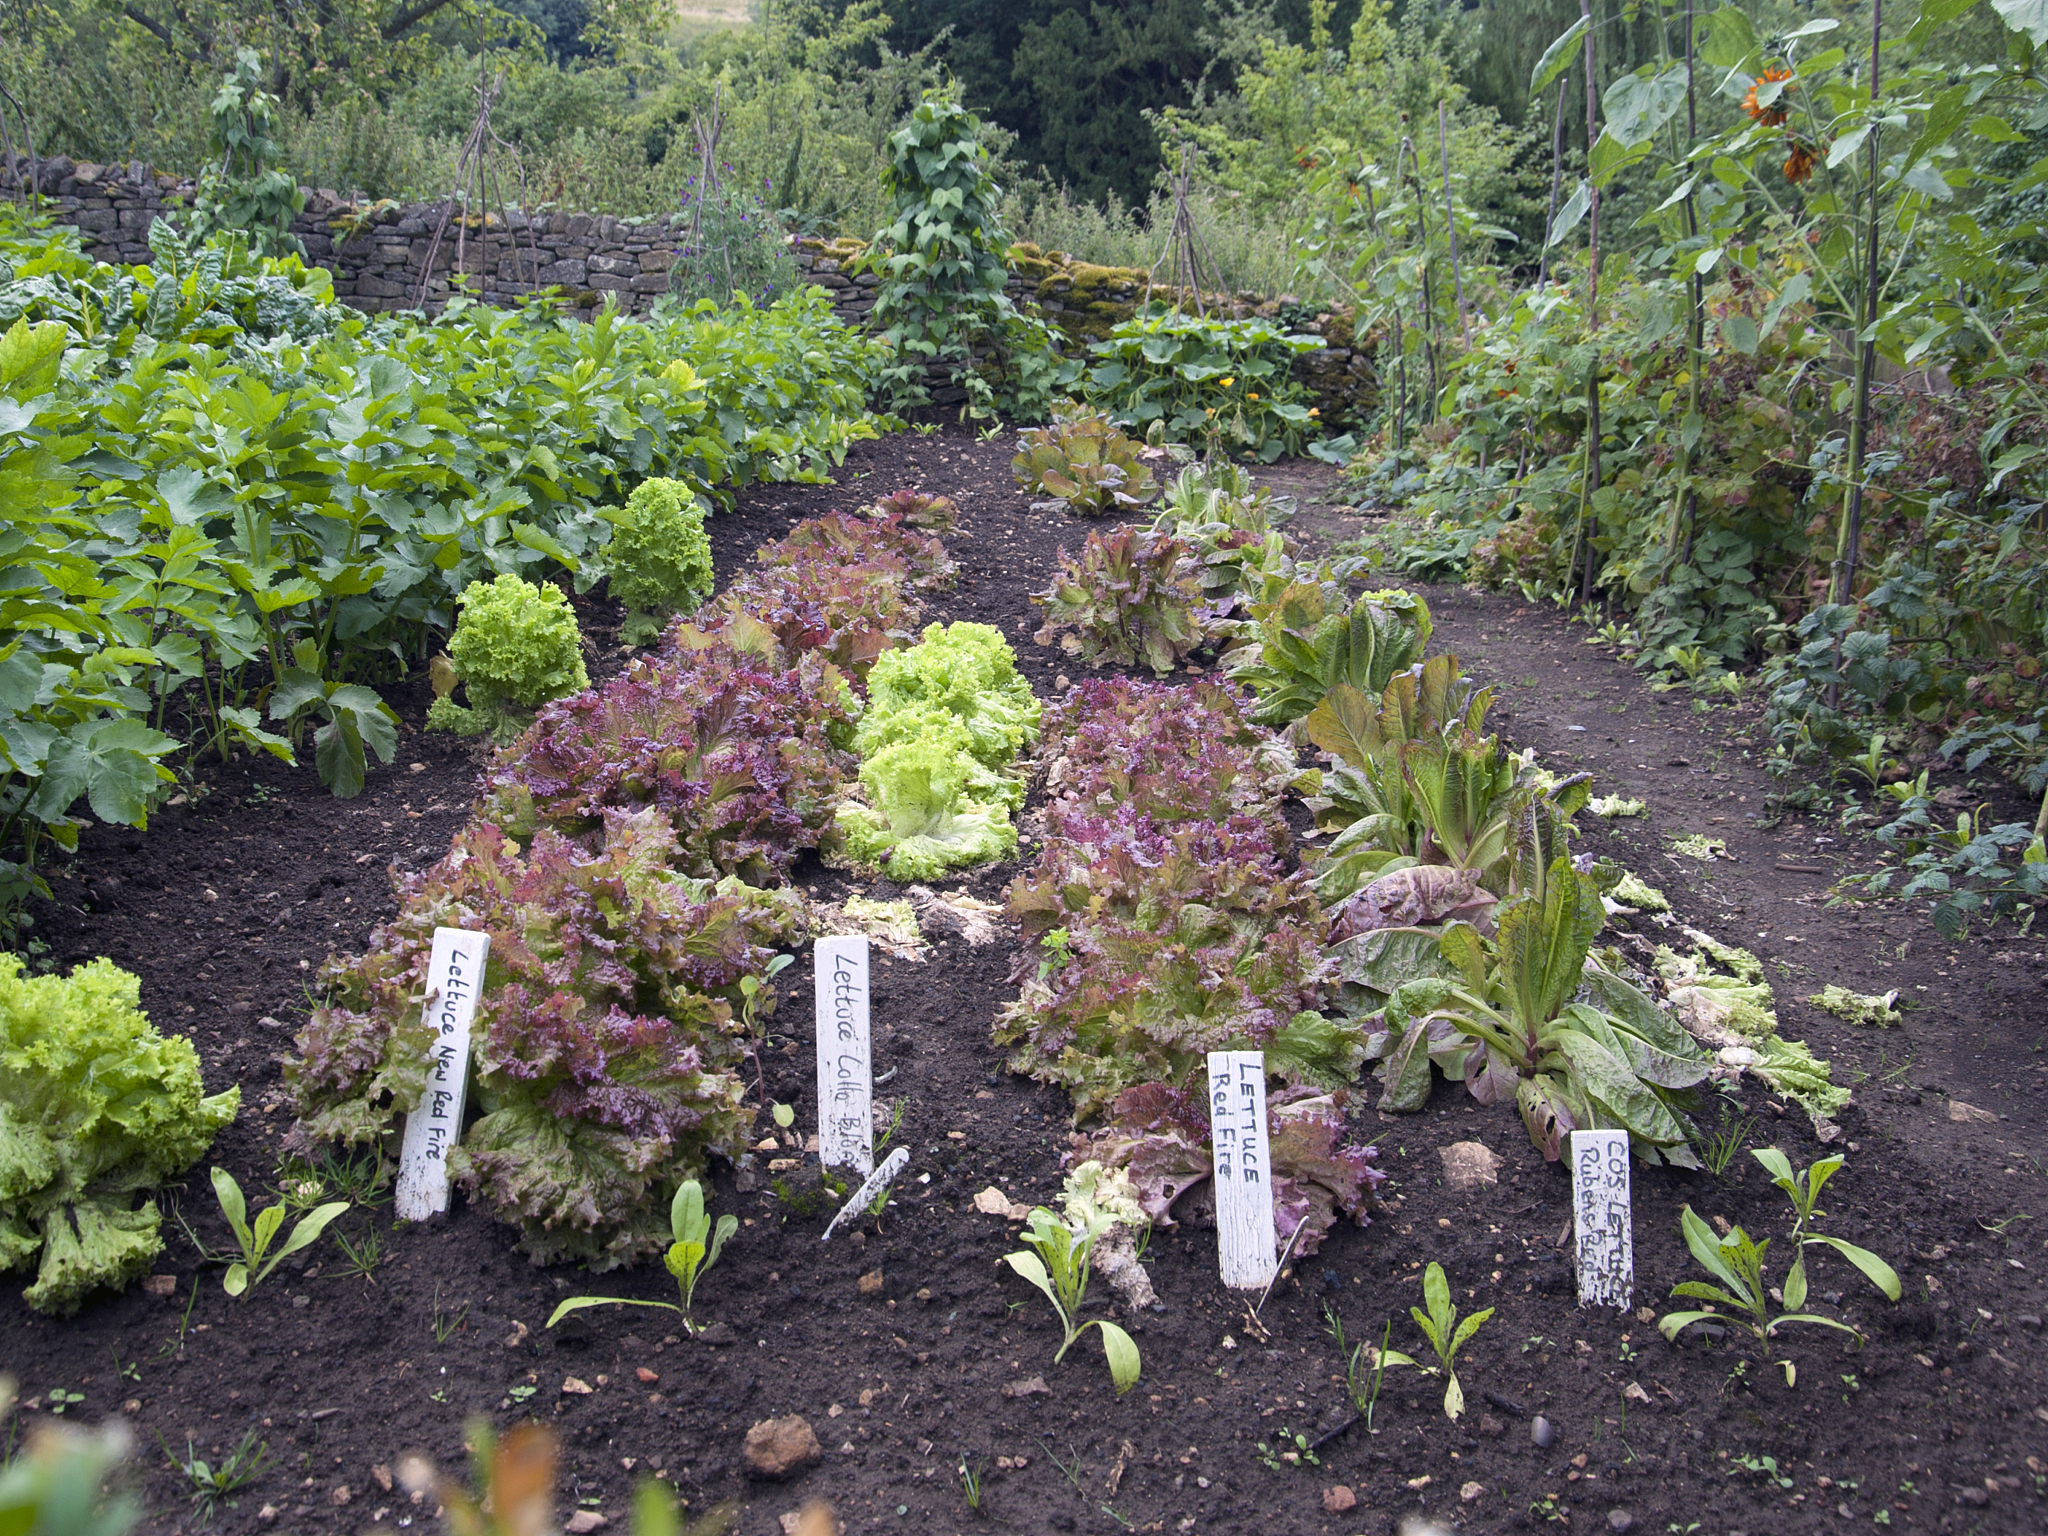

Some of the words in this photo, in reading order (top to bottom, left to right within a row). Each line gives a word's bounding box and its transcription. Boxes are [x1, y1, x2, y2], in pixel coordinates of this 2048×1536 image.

[441, 949, 470, 1035] Lettuce
[834, 954, 862, 1041] Lettuce
[434, 1045, 457, 1082] New
[430, 1090, 453, 1119] Red
[1212, 1073, 1235, 1117] Red
[426, 1127, 446, 1160] Fire
[1239, 1063, 1262, 1184] LETTUCE
[1217, 1128, 1236, 1178] Fire
